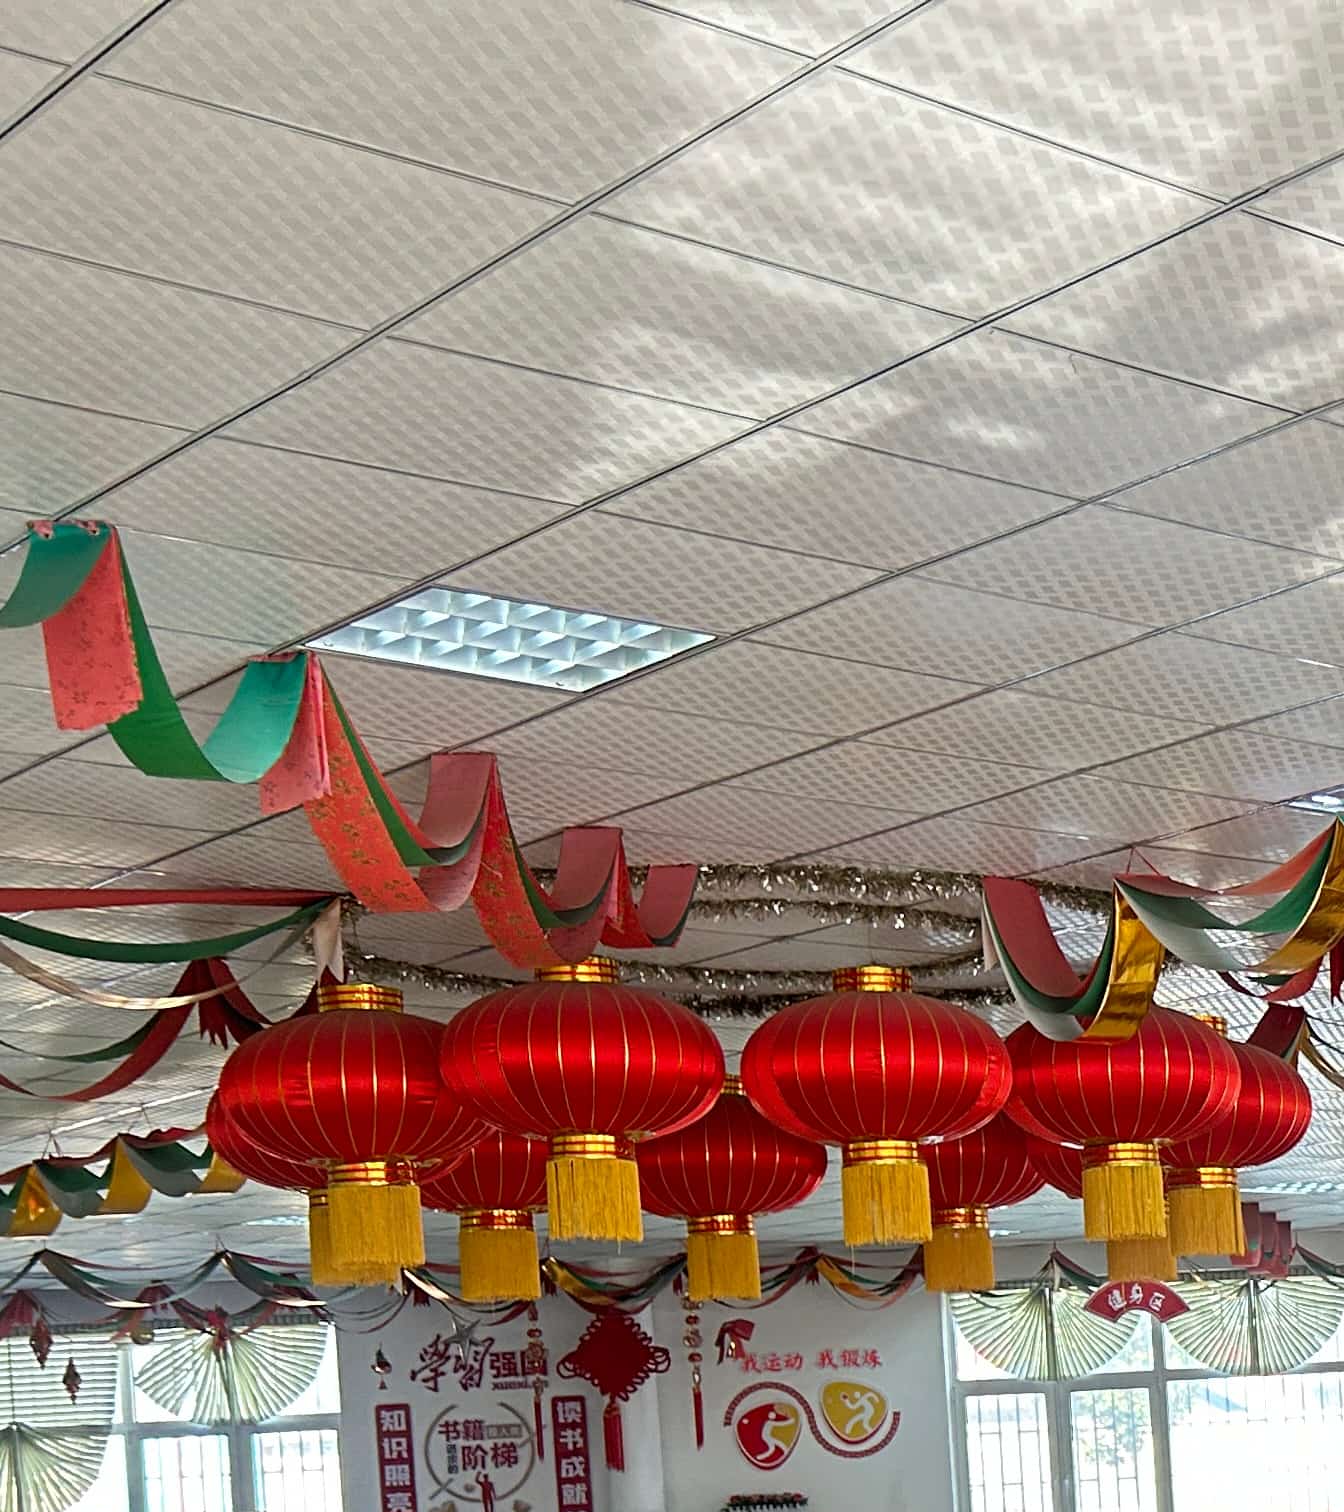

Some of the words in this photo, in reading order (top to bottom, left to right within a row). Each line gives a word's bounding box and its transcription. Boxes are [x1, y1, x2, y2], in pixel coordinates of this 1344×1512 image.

[1107, 1282, 1165, 1311] 健身区
[742, 1353, 803, 1374] 我运动
[817, 1349, 882, 1369] 我锻炼
